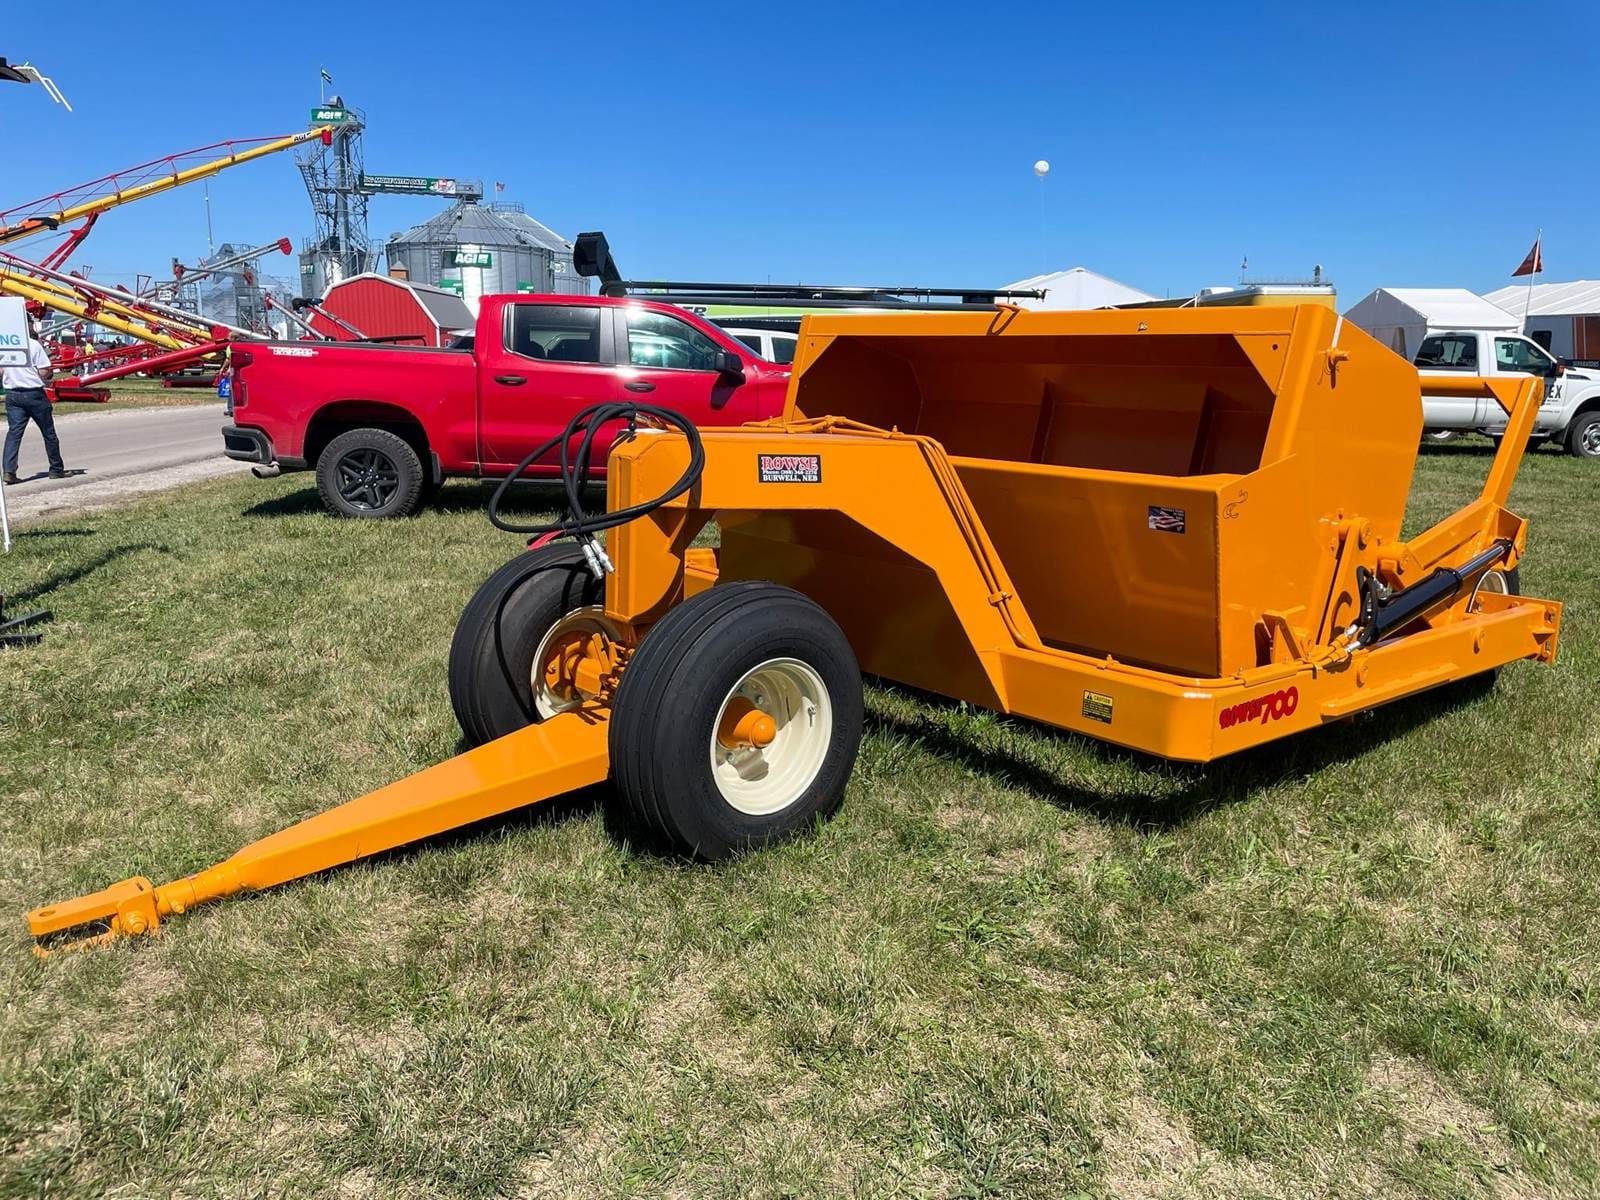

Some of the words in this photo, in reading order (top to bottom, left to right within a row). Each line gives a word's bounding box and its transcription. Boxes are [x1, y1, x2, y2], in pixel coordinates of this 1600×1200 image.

[317, 111, 334, 120] AGI
[294, 133, 306, 142] AGI
[455, 253, 477, 264] AGI
[760, 456, 818, 471] ROWSE
[762, 474, 801, 482] BURWELL,
[802, 474, 818, 482] NEB
[1261, 685, 1299, 725] 700
